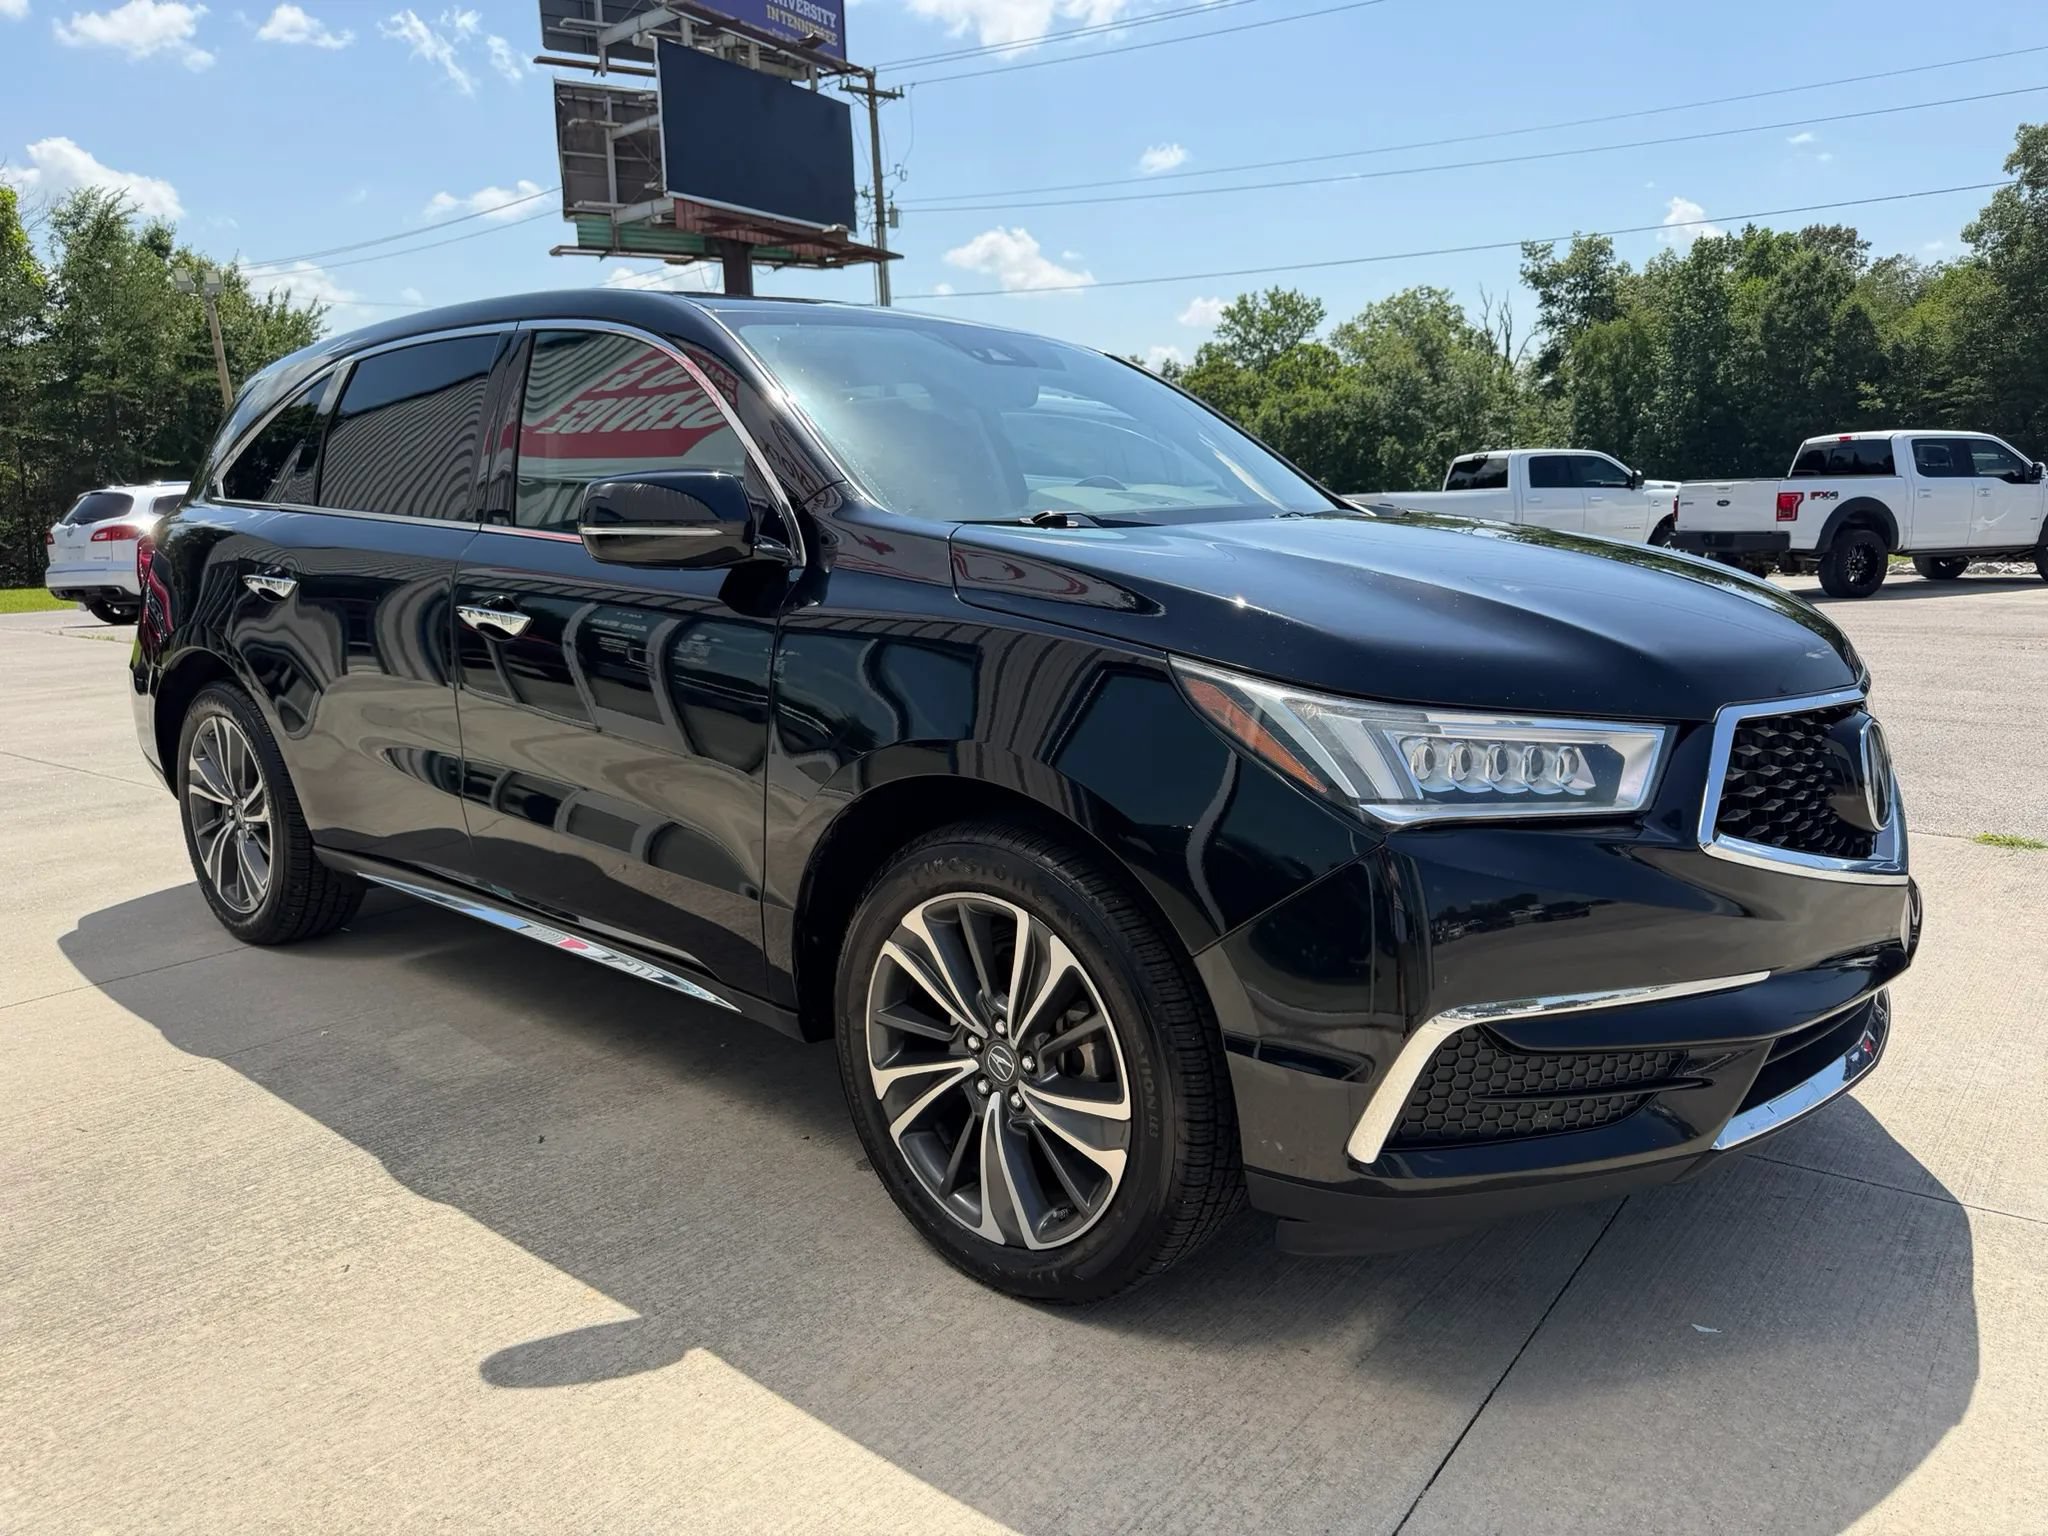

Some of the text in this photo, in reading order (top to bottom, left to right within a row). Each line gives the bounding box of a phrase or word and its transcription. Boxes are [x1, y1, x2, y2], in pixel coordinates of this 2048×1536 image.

[766, 4, 779, 21] IN
[780, 10, 837, 46] TENNEEE
[769, 0, 836, 28] IVERSITY
[1810, 491, 1839, 501] FX4
